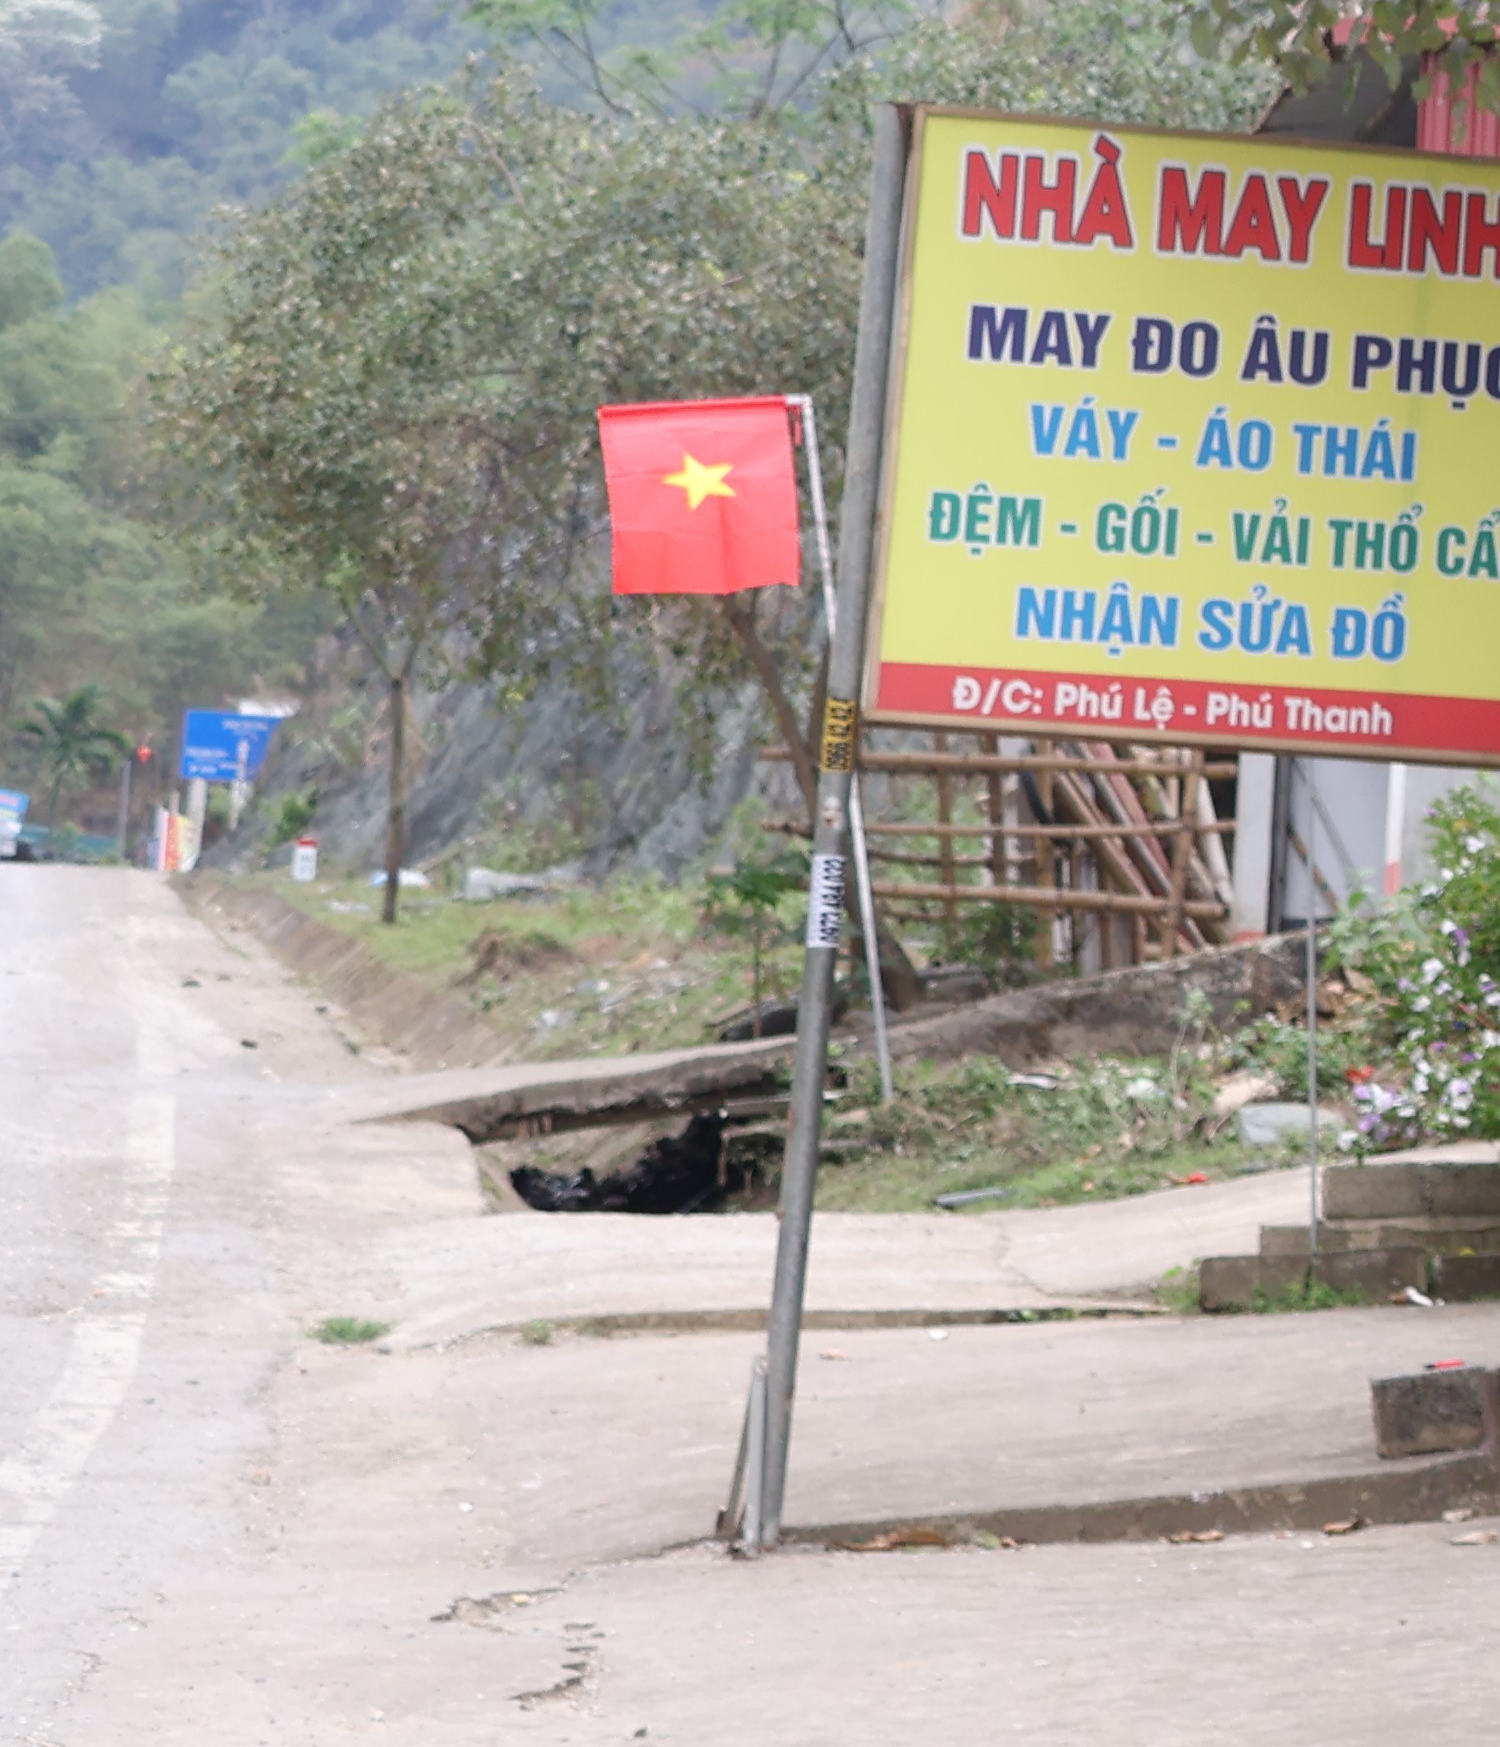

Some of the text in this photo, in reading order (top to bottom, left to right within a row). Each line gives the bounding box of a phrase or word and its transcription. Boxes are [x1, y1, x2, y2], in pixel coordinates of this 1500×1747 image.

[963, 134, 1134, 249] NHÀ
[1157, 166, 1330, 263] MAY
[967, 304, 1111, 370] MAY
[1131, 316, 1220, 378] ĐO
[1240, 313, 1330, 386] ÂU
[1029, 396, 1140, 461] VÁY
[1195, 406, 1274, 472] ÁO
[1292, 416, 1418, 483] THÁI
[927, 483, 1042, 555] ĐỆM
[1095, 487, 1179, 557] GỐI
[1232, 497, 1311, 567] VẢI
[1329, 503, 1425, 574] THỔ
[1014, 581, 1409, 663] NHẬN SỬA ĐỒ
[952, 675, 1044, 717] Đ/C:
[1053, 681, 1123, 721] Phú
[1134, 686, 1176, 731] Lệ
[1205, 691, 1274, 729] Phú
[1284, 697, 1394, 736] Thanh
